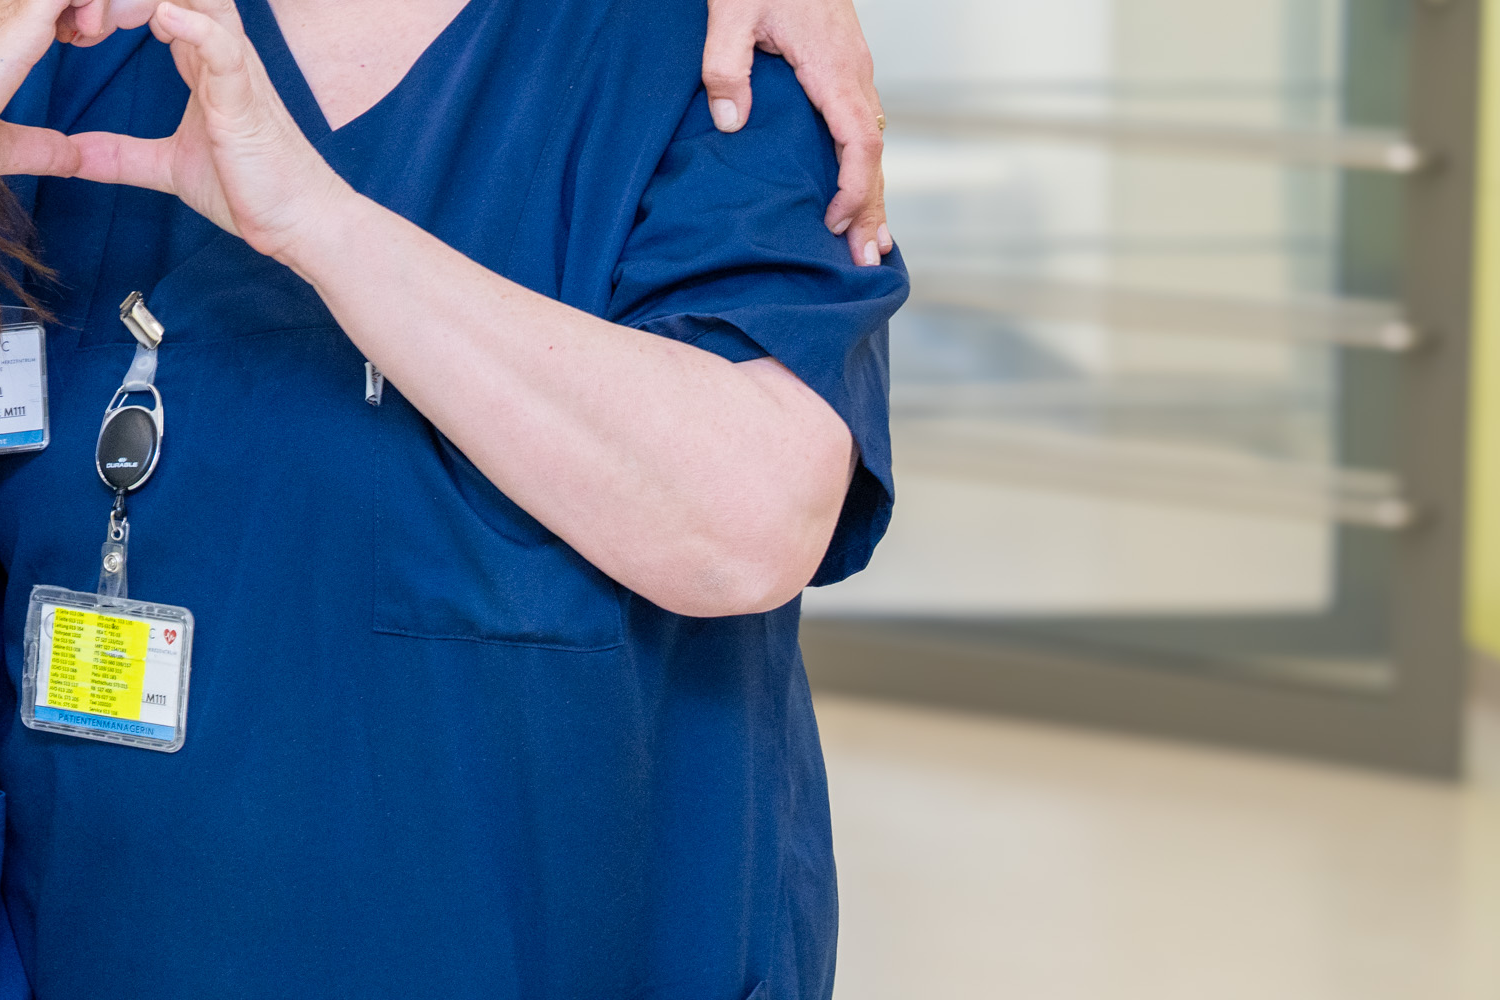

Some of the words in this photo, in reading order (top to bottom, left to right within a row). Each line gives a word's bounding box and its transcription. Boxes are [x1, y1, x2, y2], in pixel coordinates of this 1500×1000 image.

[4, 406, 26, 418] M111
[146, 693, 167, 703] M111
[58, 713, 155, 736] PATIENTENMANAGERIN
